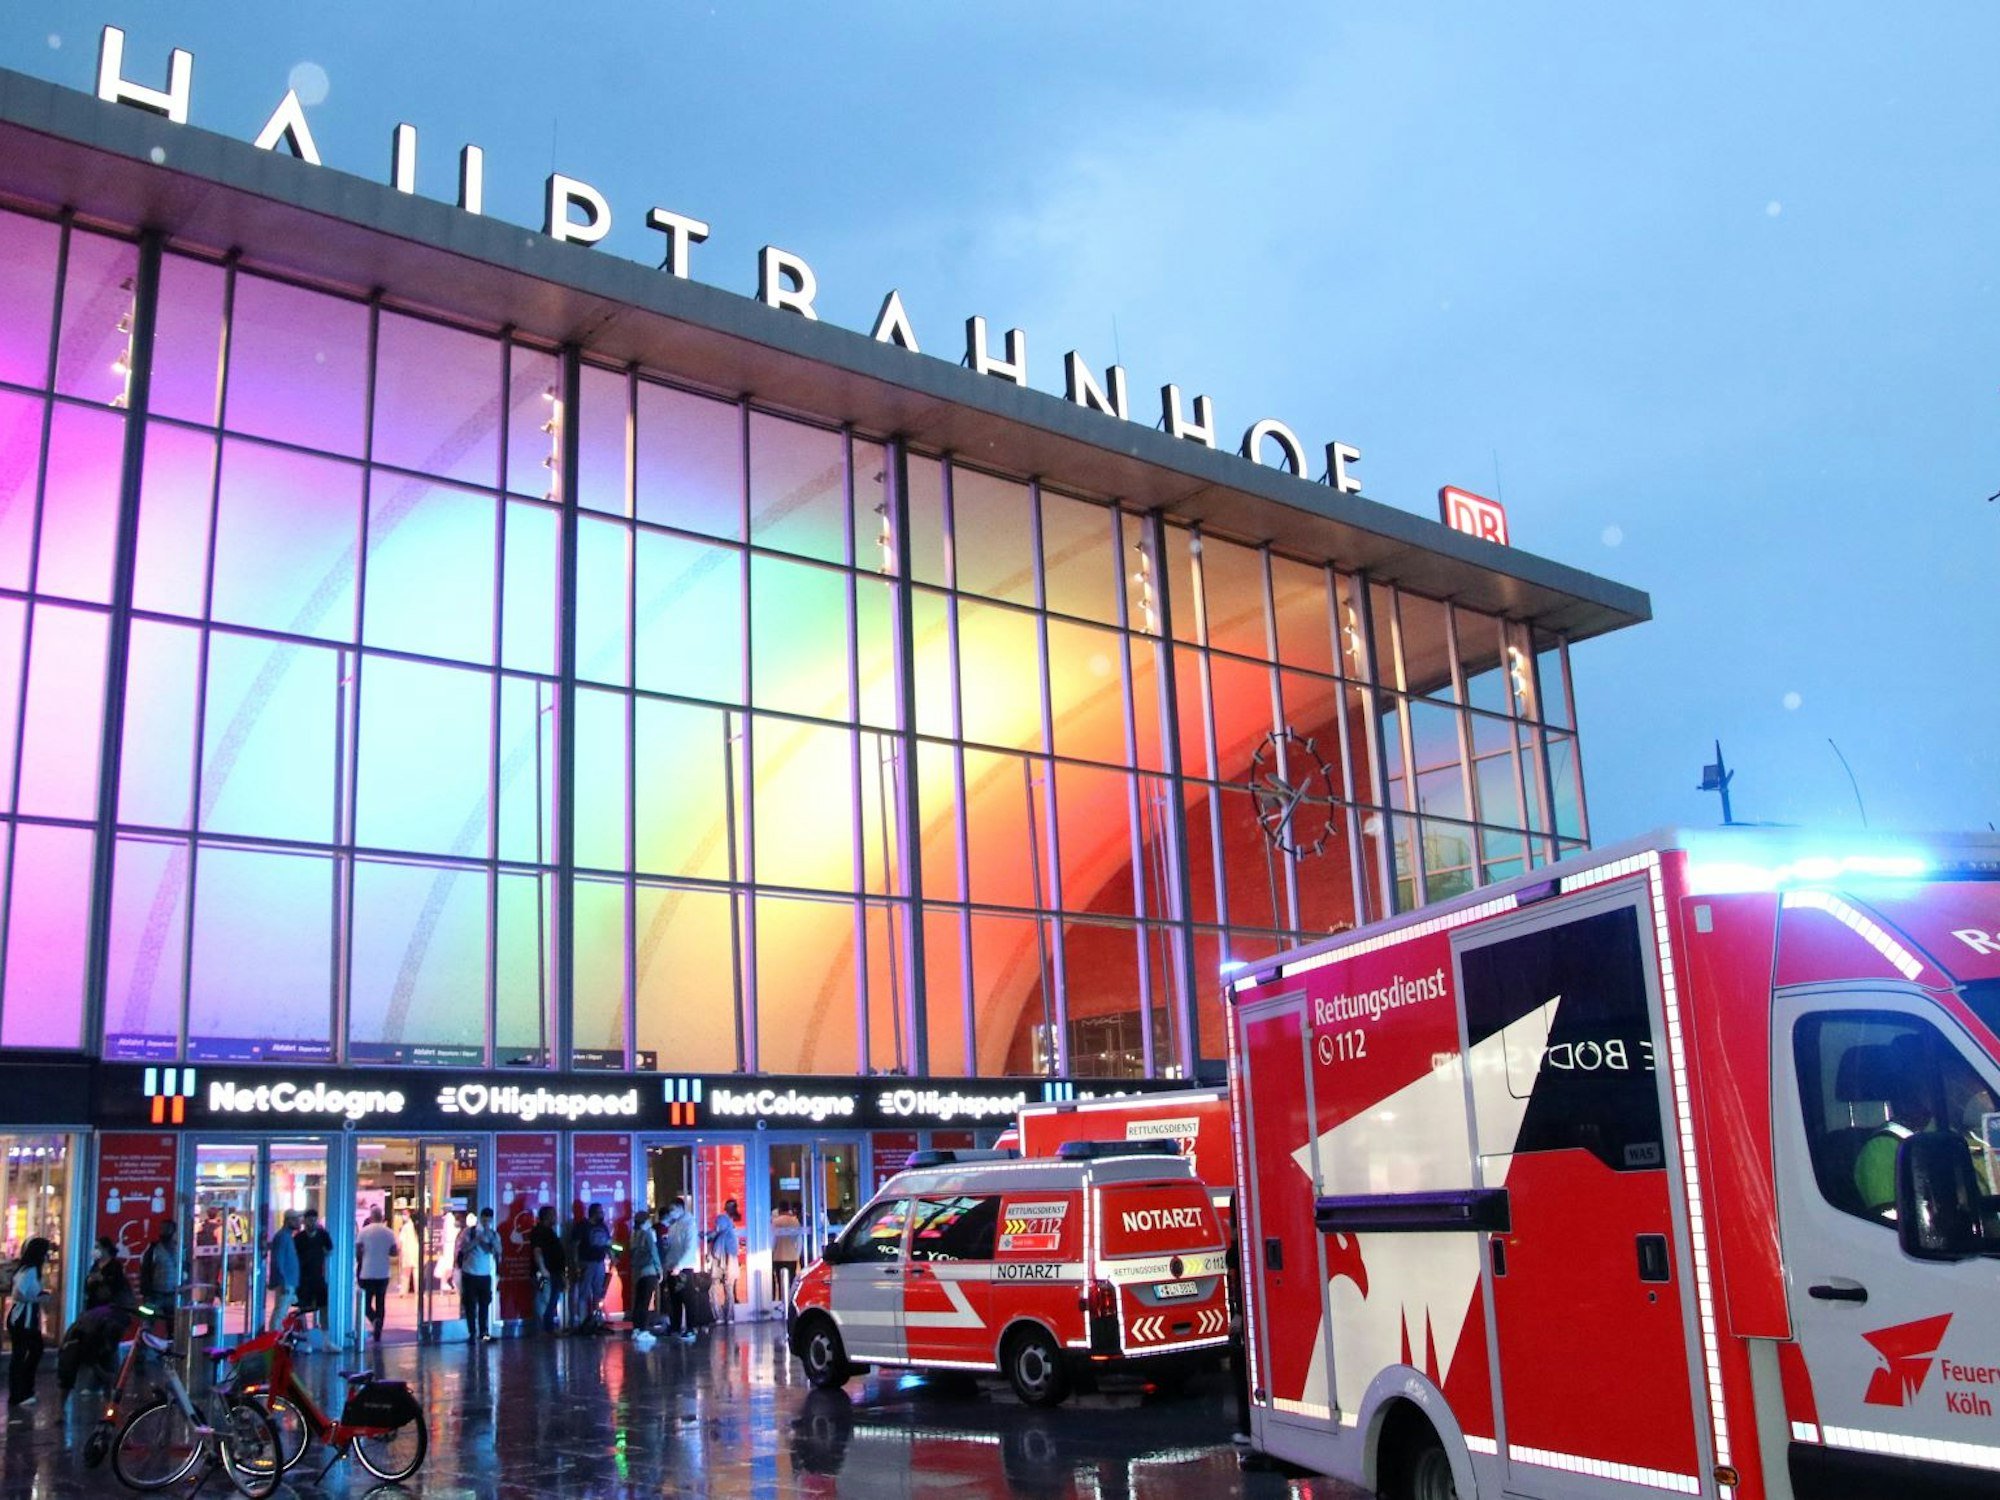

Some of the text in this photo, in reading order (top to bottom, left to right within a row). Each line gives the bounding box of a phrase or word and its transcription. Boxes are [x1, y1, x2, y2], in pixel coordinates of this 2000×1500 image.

[98, 25, 1361, 494] HAUPTBAHNHOF
[1951, 928, 2000, 954] R
[1314, 967, 1447, 1026] Rettungsdienst
[1336, 1028, 1367, 1062] 112
[209, 1081, 405, 1120] NetCologne
[489, 1086, 639, 1122] Highspeed
[711, 1089, 855, 1121] NetCologne
[917, 1091, 1026, 1119] Highspeed
[1128, 1122, 1197, 1136] RETTUNGSDIENST
[1174, 1136, 1196, 1156] 12
[1628, 1147, 1654, 1161] WAS
[1007, 1205, 1065, 1216] RETTUNGSDIENST
[1121, 1207, 1202, 1233] NOTARZT
[1040, 1219, 1062, 1233] 112
[997, 1264, 1062, 1279] NOTARZT
[1945, 1391, 1992, 1416] Köln
